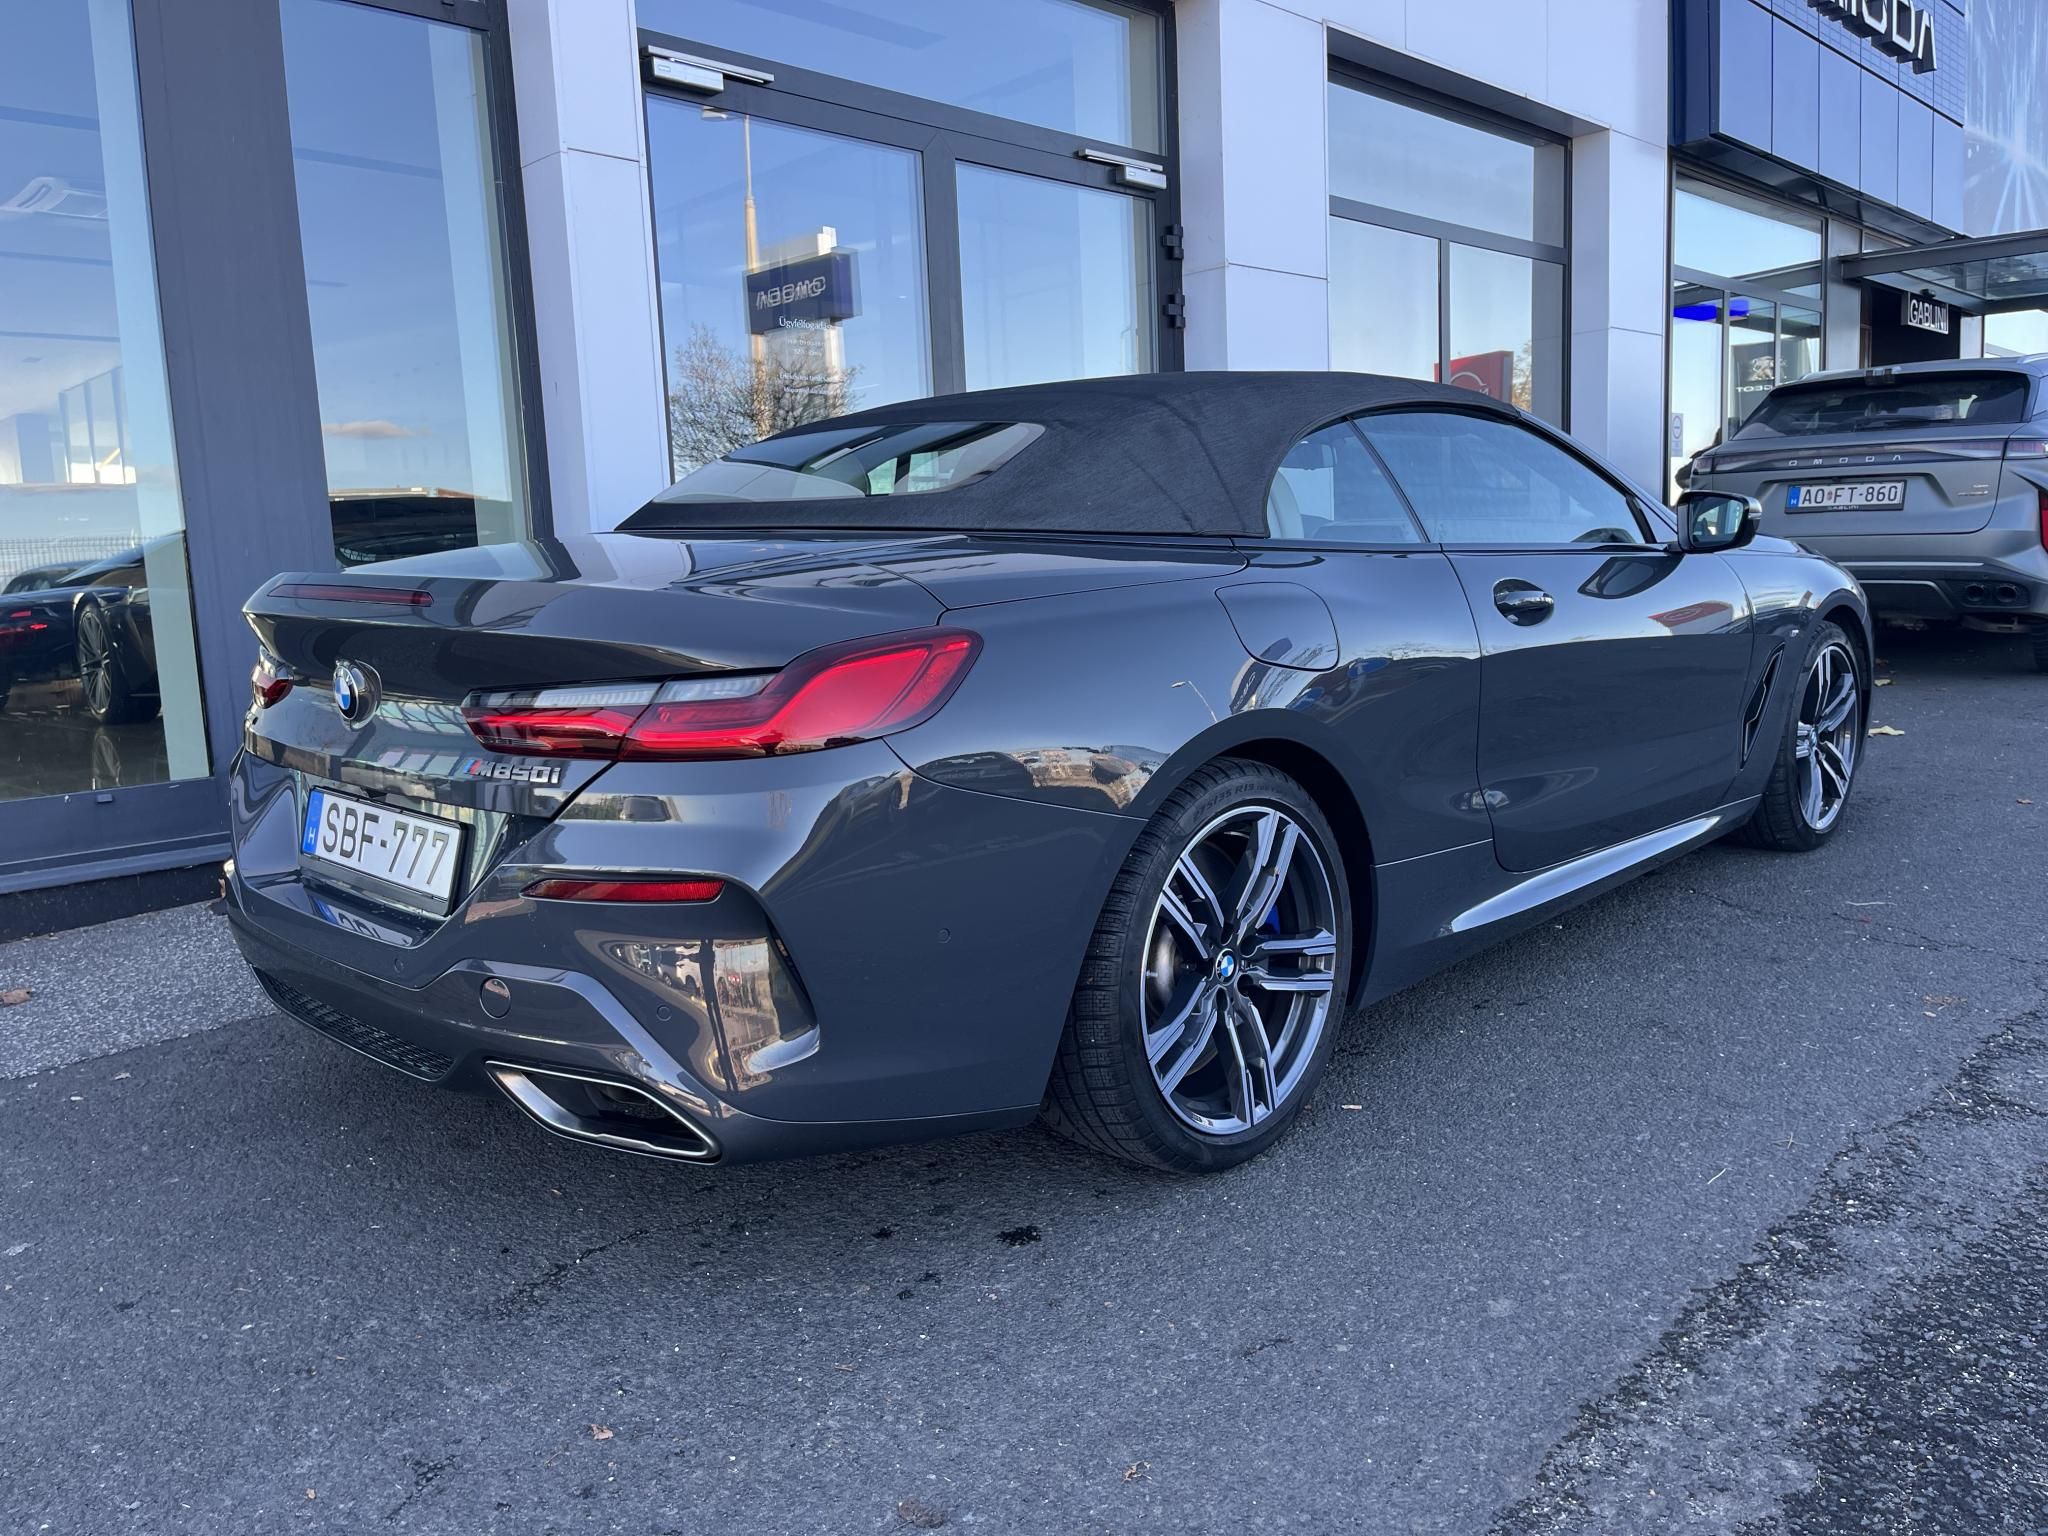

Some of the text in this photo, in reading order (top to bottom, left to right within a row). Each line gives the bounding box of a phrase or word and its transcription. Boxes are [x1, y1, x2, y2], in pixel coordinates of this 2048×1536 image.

[1910, 299, 1947, 331] GABLINI
[1788, 455, 1901, 467] OMODA
[322, 802, 450, 885] SBF-777
